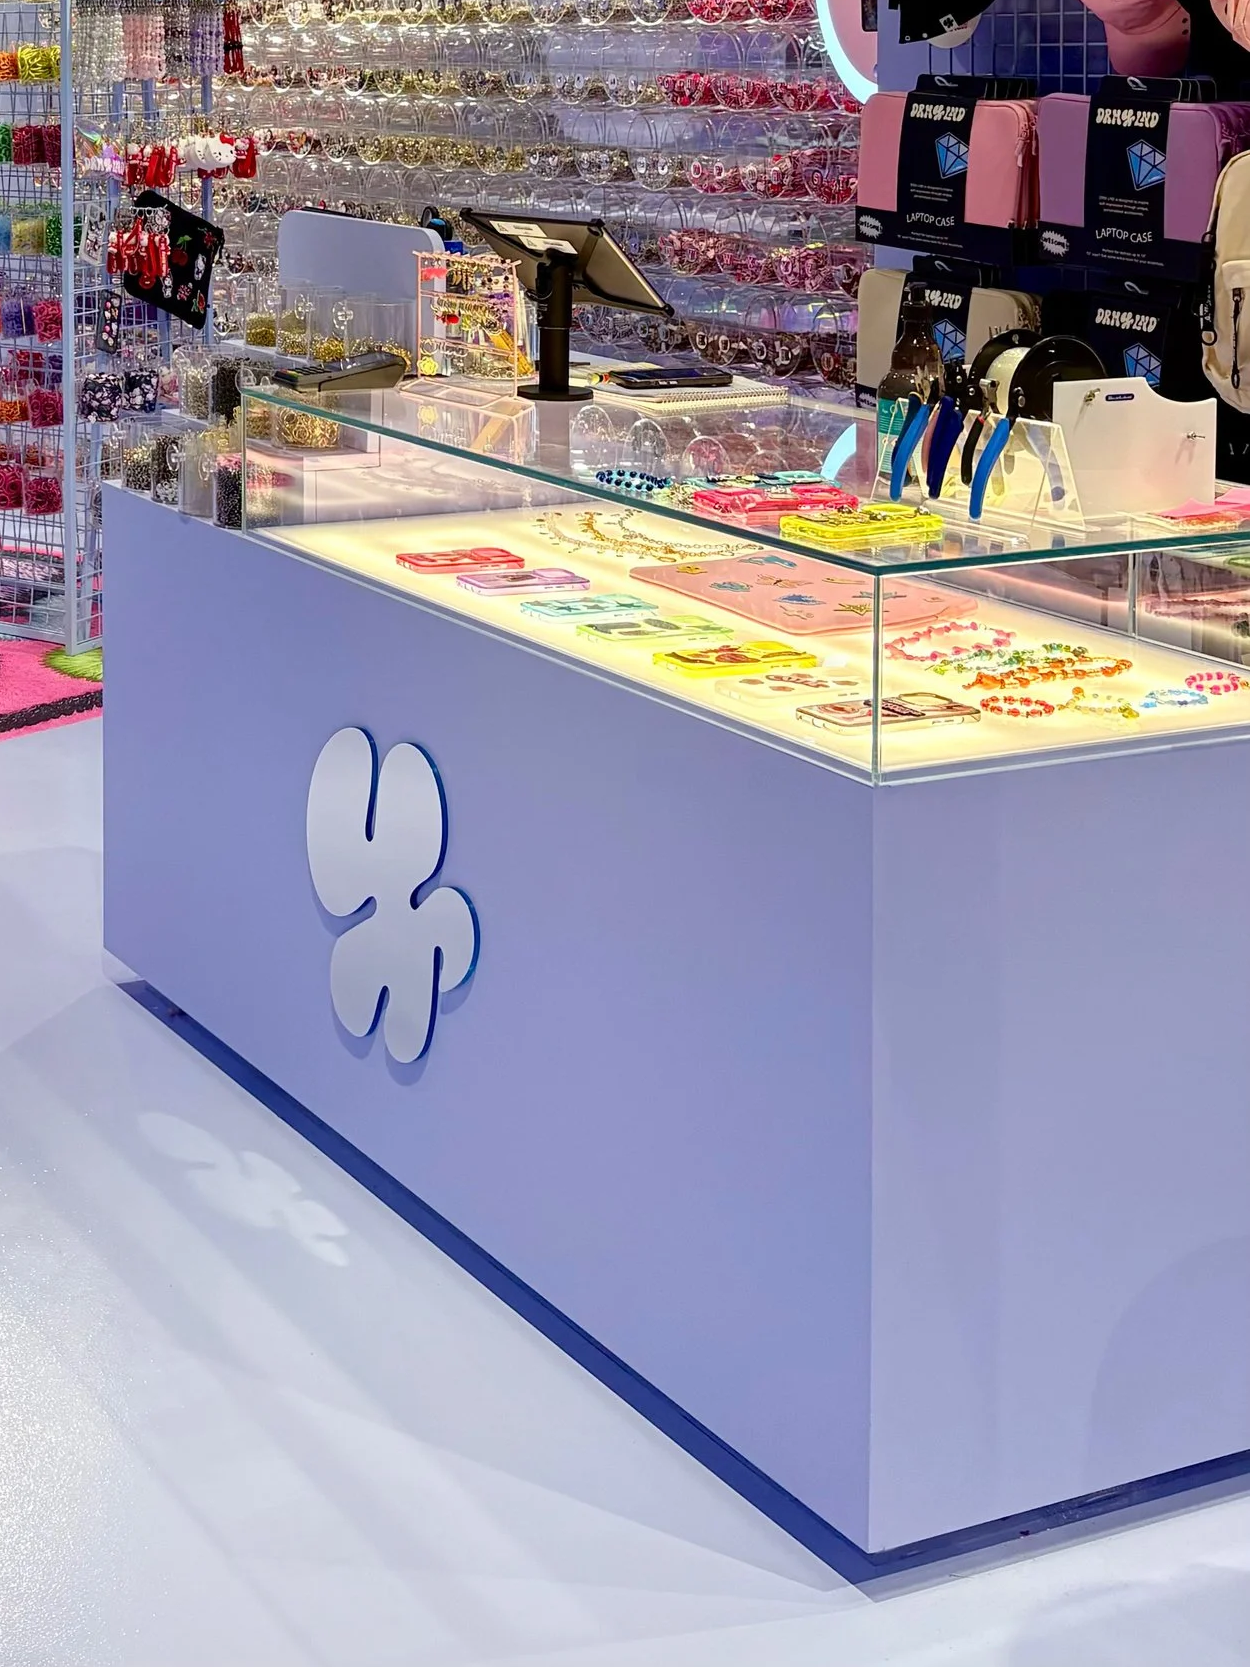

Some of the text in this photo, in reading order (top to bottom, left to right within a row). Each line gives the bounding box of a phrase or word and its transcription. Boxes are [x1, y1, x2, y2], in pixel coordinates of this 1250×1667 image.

[906, 212, 955, 227] LAPTOP CASE
[1095, 228, 1153, 243] LAPTOP CASE
